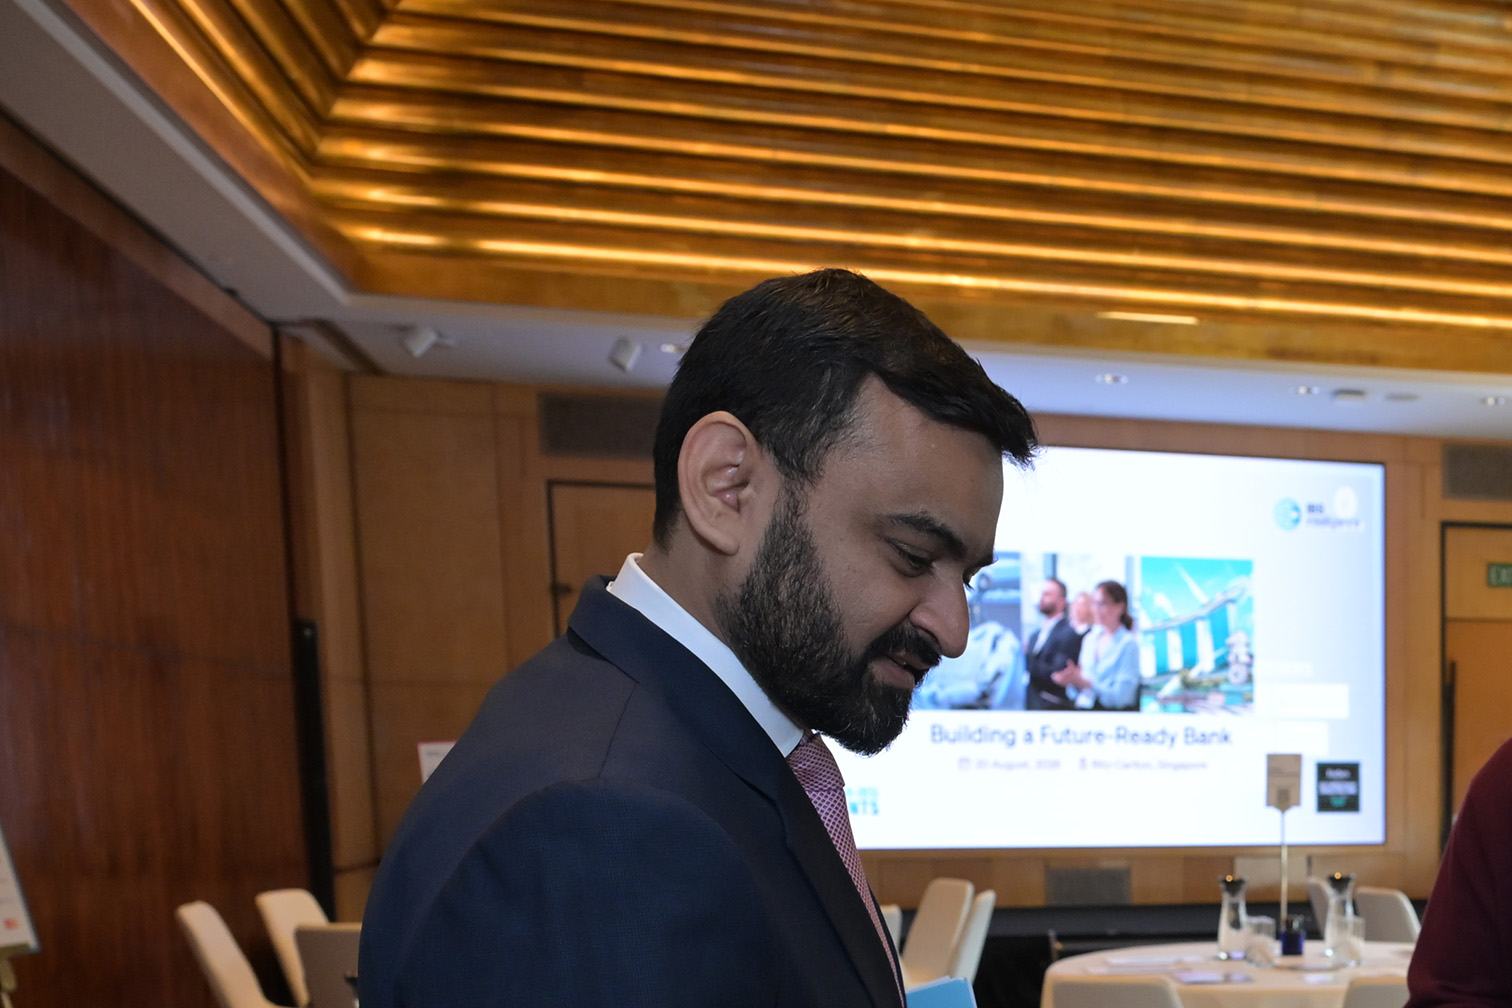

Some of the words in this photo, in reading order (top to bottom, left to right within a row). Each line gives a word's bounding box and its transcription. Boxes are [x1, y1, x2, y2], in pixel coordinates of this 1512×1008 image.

[930, 724, 1017, 748] Building
[1023, 730, 1034, 745] a
[1040, 725, 1177, 748] Future-Ready
[1184, 726, 1233, 746] Bank
